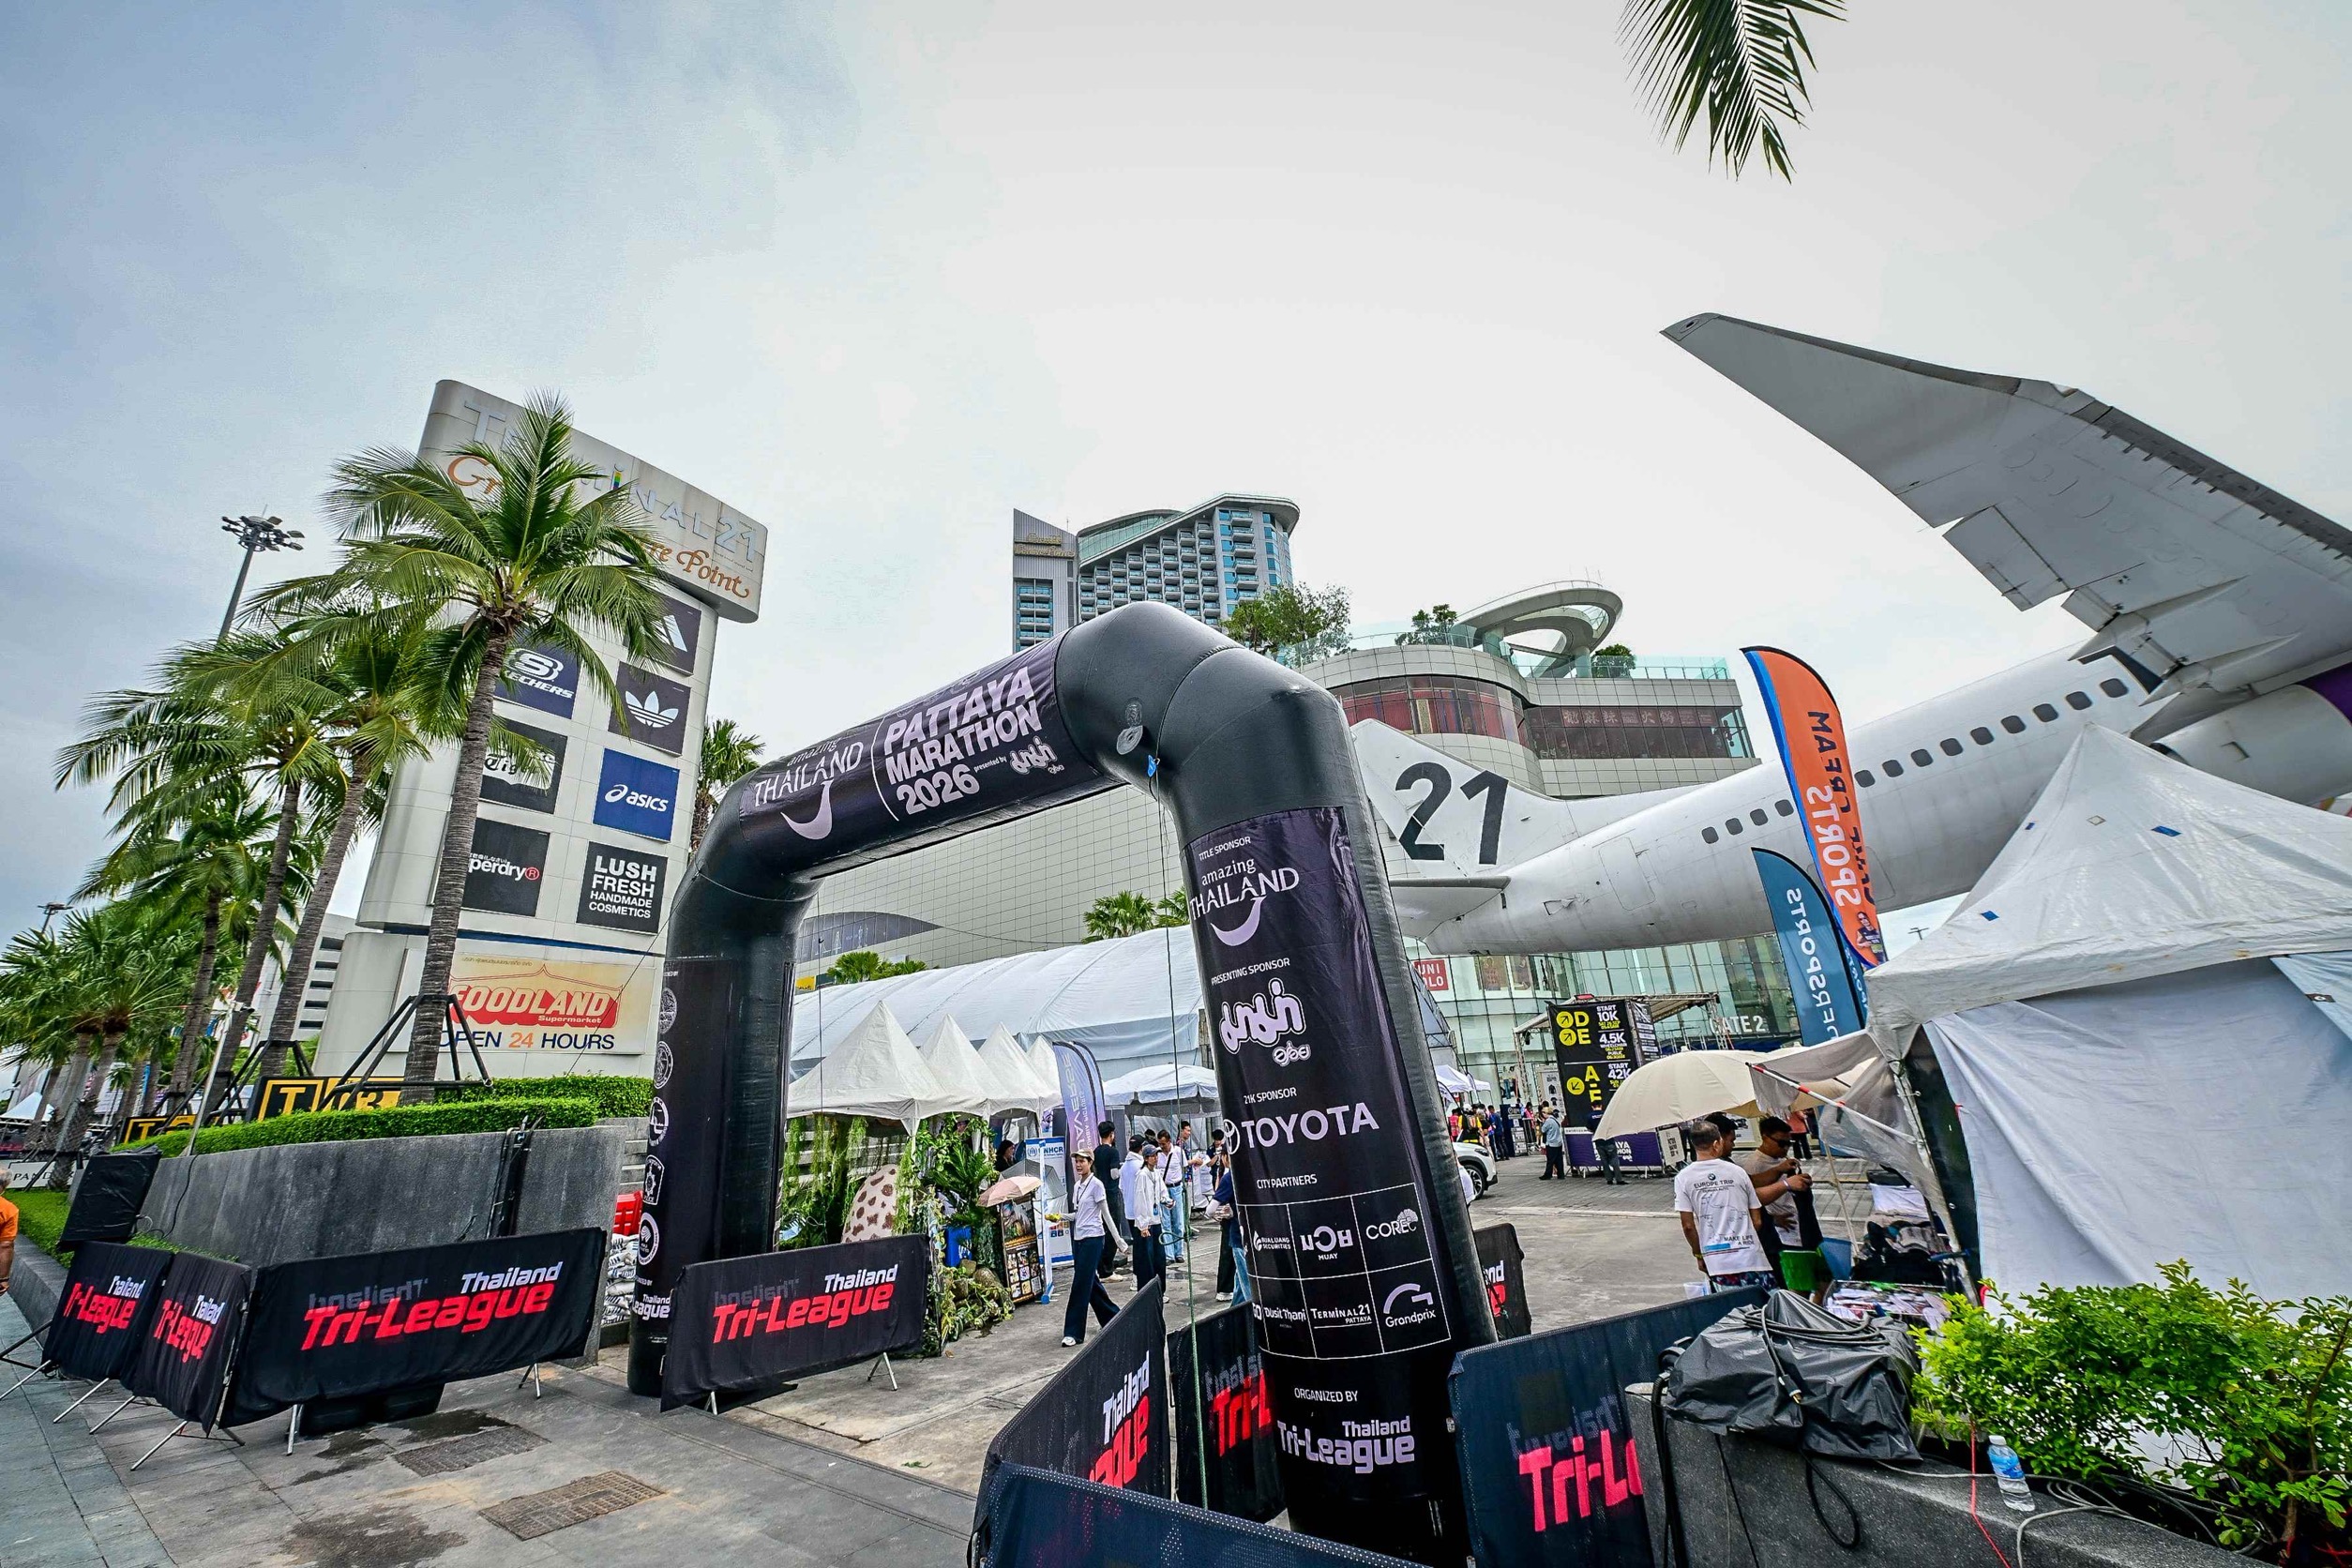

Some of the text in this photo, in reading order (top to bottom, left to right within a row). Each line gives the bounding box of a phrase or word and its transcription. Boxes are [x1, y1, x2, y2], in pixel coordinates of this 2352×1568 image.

[676, 550, 750, 599] Point
[505, 670, 574, 699] KECHERS
[883, 666, 1034, 755] PATTAYA
[885, 700, 1043, 785] MARATHON
[753, 741, 864, 807] THAILAND
[973, 756, 1007, 774] presented by
[897, 763, 980, 815] 2026
[1395, 761, 1509, 865] 21
[1199, 837, 1251, 862] TITLE SPONSOR
[595, 855, 657, 882] LUSH
[1201, 858, 1255, 886] amazing
[592, 874, 655, 898] FRESH
[1189, 867, 1300, 920] THAILAND
[589, 902, 651, 919] COSMETICS
[590, 891, 653, 908] HANDMADE
[1211, 957, 1290, 986] PRESENTING SPONSOR
[450, 985, 611, 1017] FOODLAND
[537, 1015, 602, 1023] Supermarket
[1574, 1011, 1590, 1027] D
[1597, 1011, 1620, 1021] 10K
[1753, 1016, 1766, 1033] 2
[508, 1032, 534, 1048] 24
[541, 1033, 615, 1049] HOURS
[1577, 1029, 1591, 1045] E
[1599, 1033, 1626, 1044] 4.5K
[1585, 1065, 1601, 1082] A
[1608, 1068, 1632, 1079] 42K
[279, 1087, 306, 1114] T
[1243, 1087, 1297, 1105] 21K SPONSOR
[1242, 1102, 1380, 1149] TOYOTA
[1257, 1174, 1318, 1189] CITY PARTNERS
[461, 1261, 563, 1294] Thailand
[824, 1263, 897, 1293] Thailand
[642, 1293, 671, 1304] Thailand
[300, 1281, 554, 1350] Tri-League
[713, 1284, 895, 1344] Tri-League
[1263, 1306, 1283, 1319] Dusit
[1283, 1307, 1306, 1322] Thani
[1345, 1316, 1372, 1324] PATTAYA
[1385, 1308, 1436, 1328] Grandprix
[1294, 1387, 1358, 1403] ORGANIZED BY
[1214, 1369, 1271, 1456] Tri-L
[1341, 1415, 1411, 1437] Thailand
[1276, 1420, 1415, 1473] Tri-League
[1518, 1428, 1644, 1532] Tri-L
